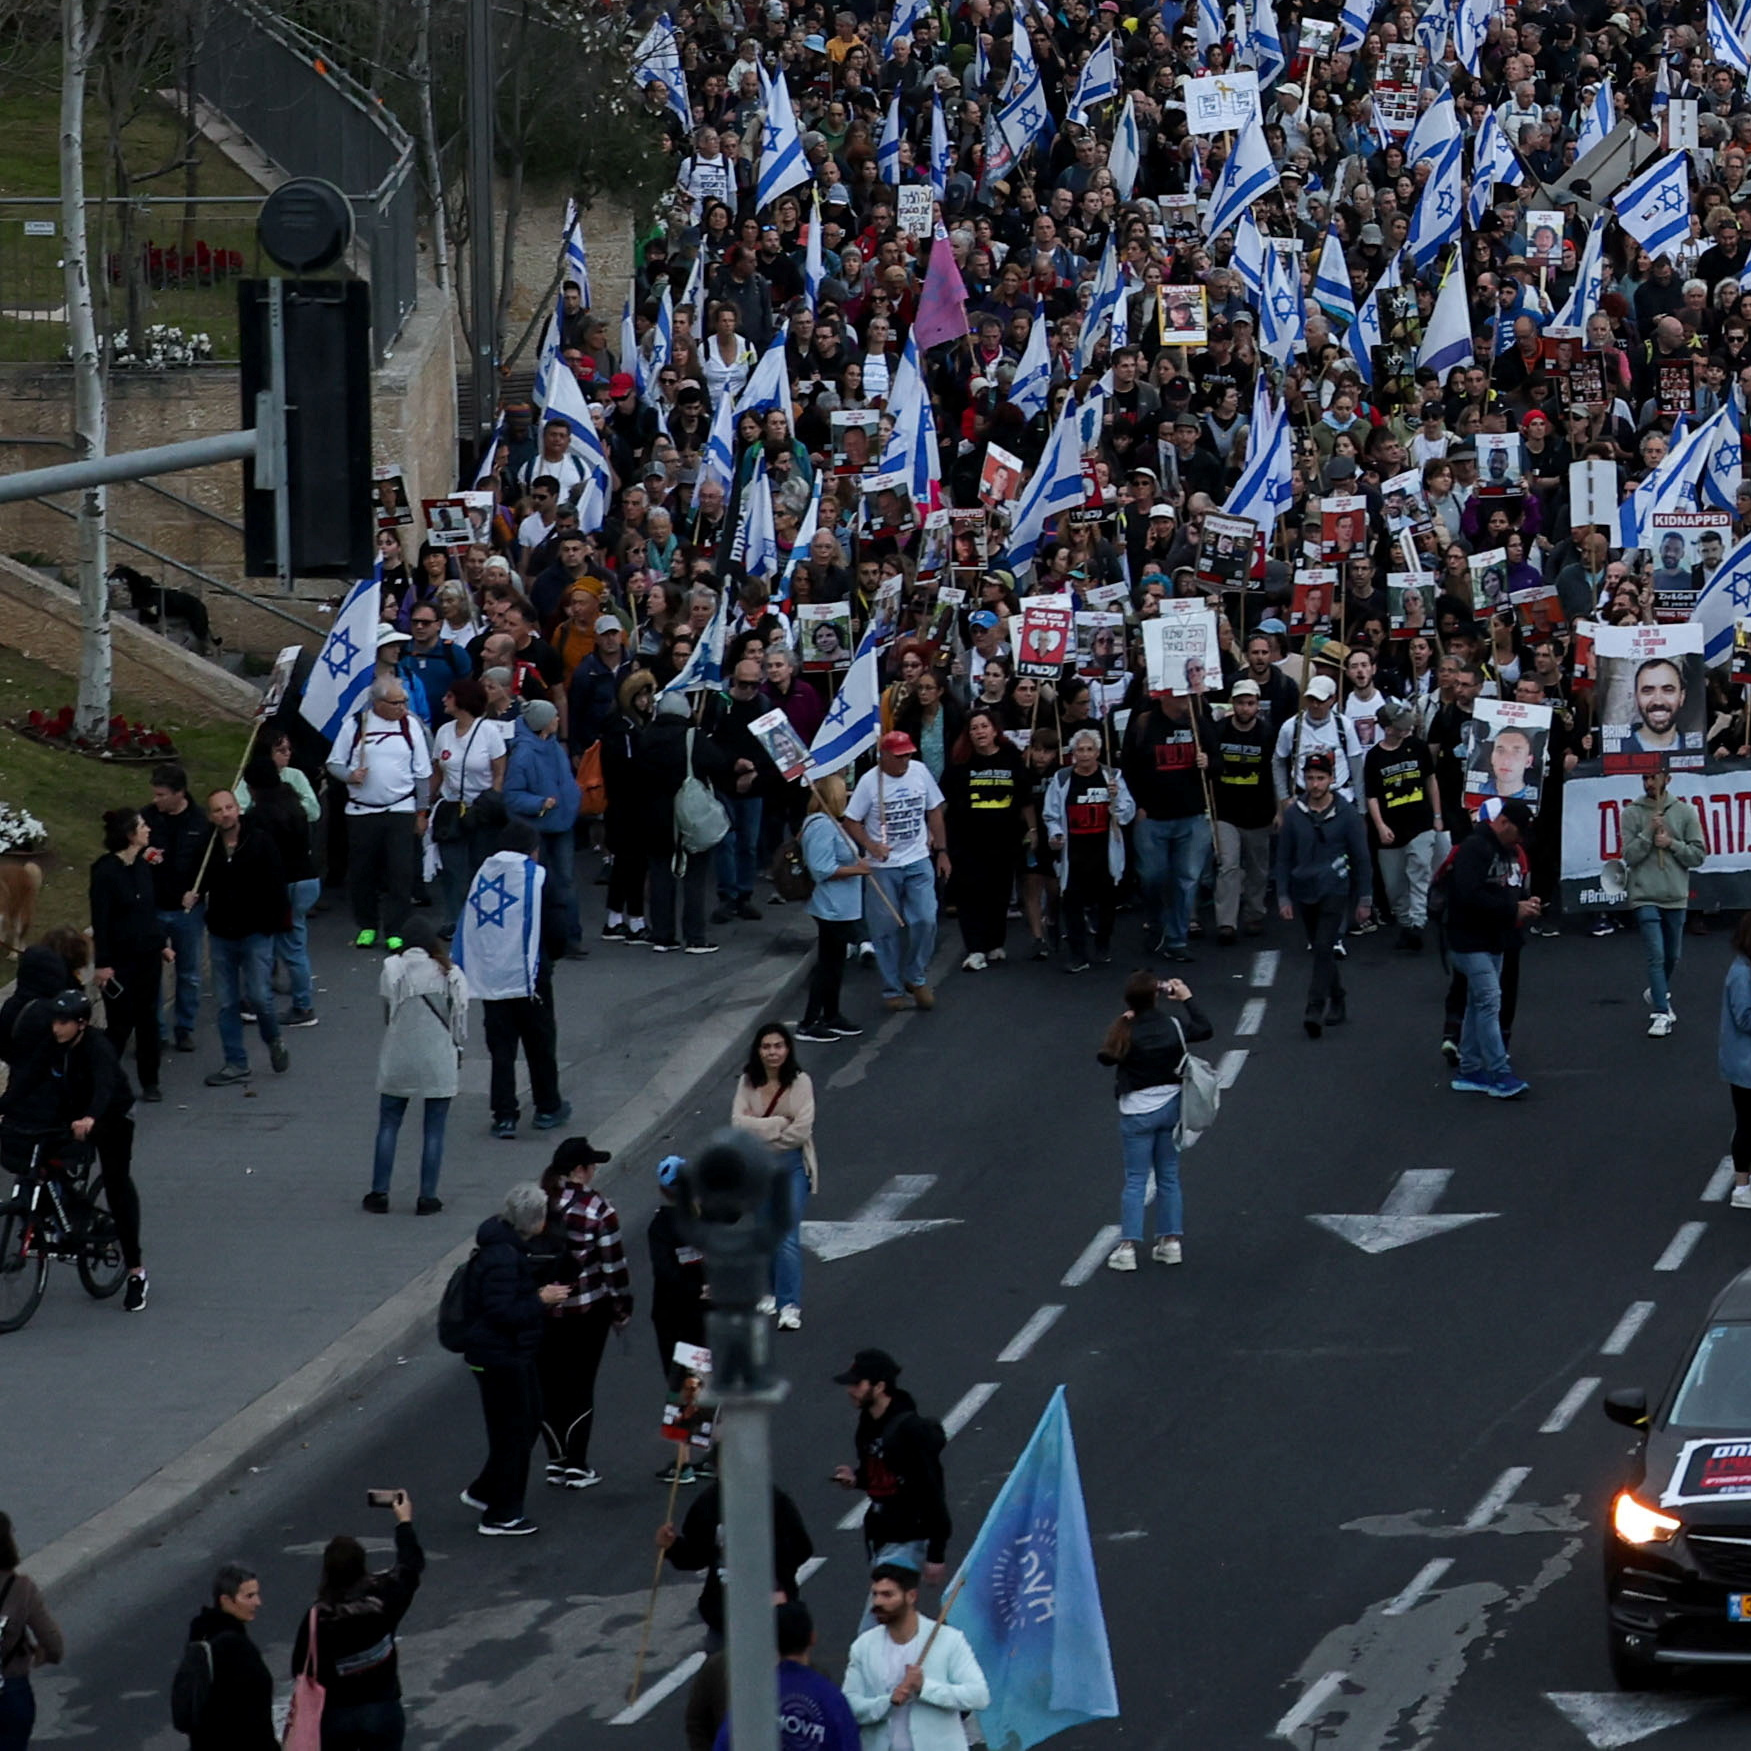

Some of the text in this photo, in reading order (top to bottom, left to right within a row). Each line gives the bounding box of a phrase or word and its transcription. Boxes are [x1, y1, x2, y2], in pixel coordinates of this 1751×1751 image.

[1653, 514, 1729, 528] KIDNAPPED
[1602, 724, 1631, 740] BRING
[1602, 739, 1621, 753] HIM
